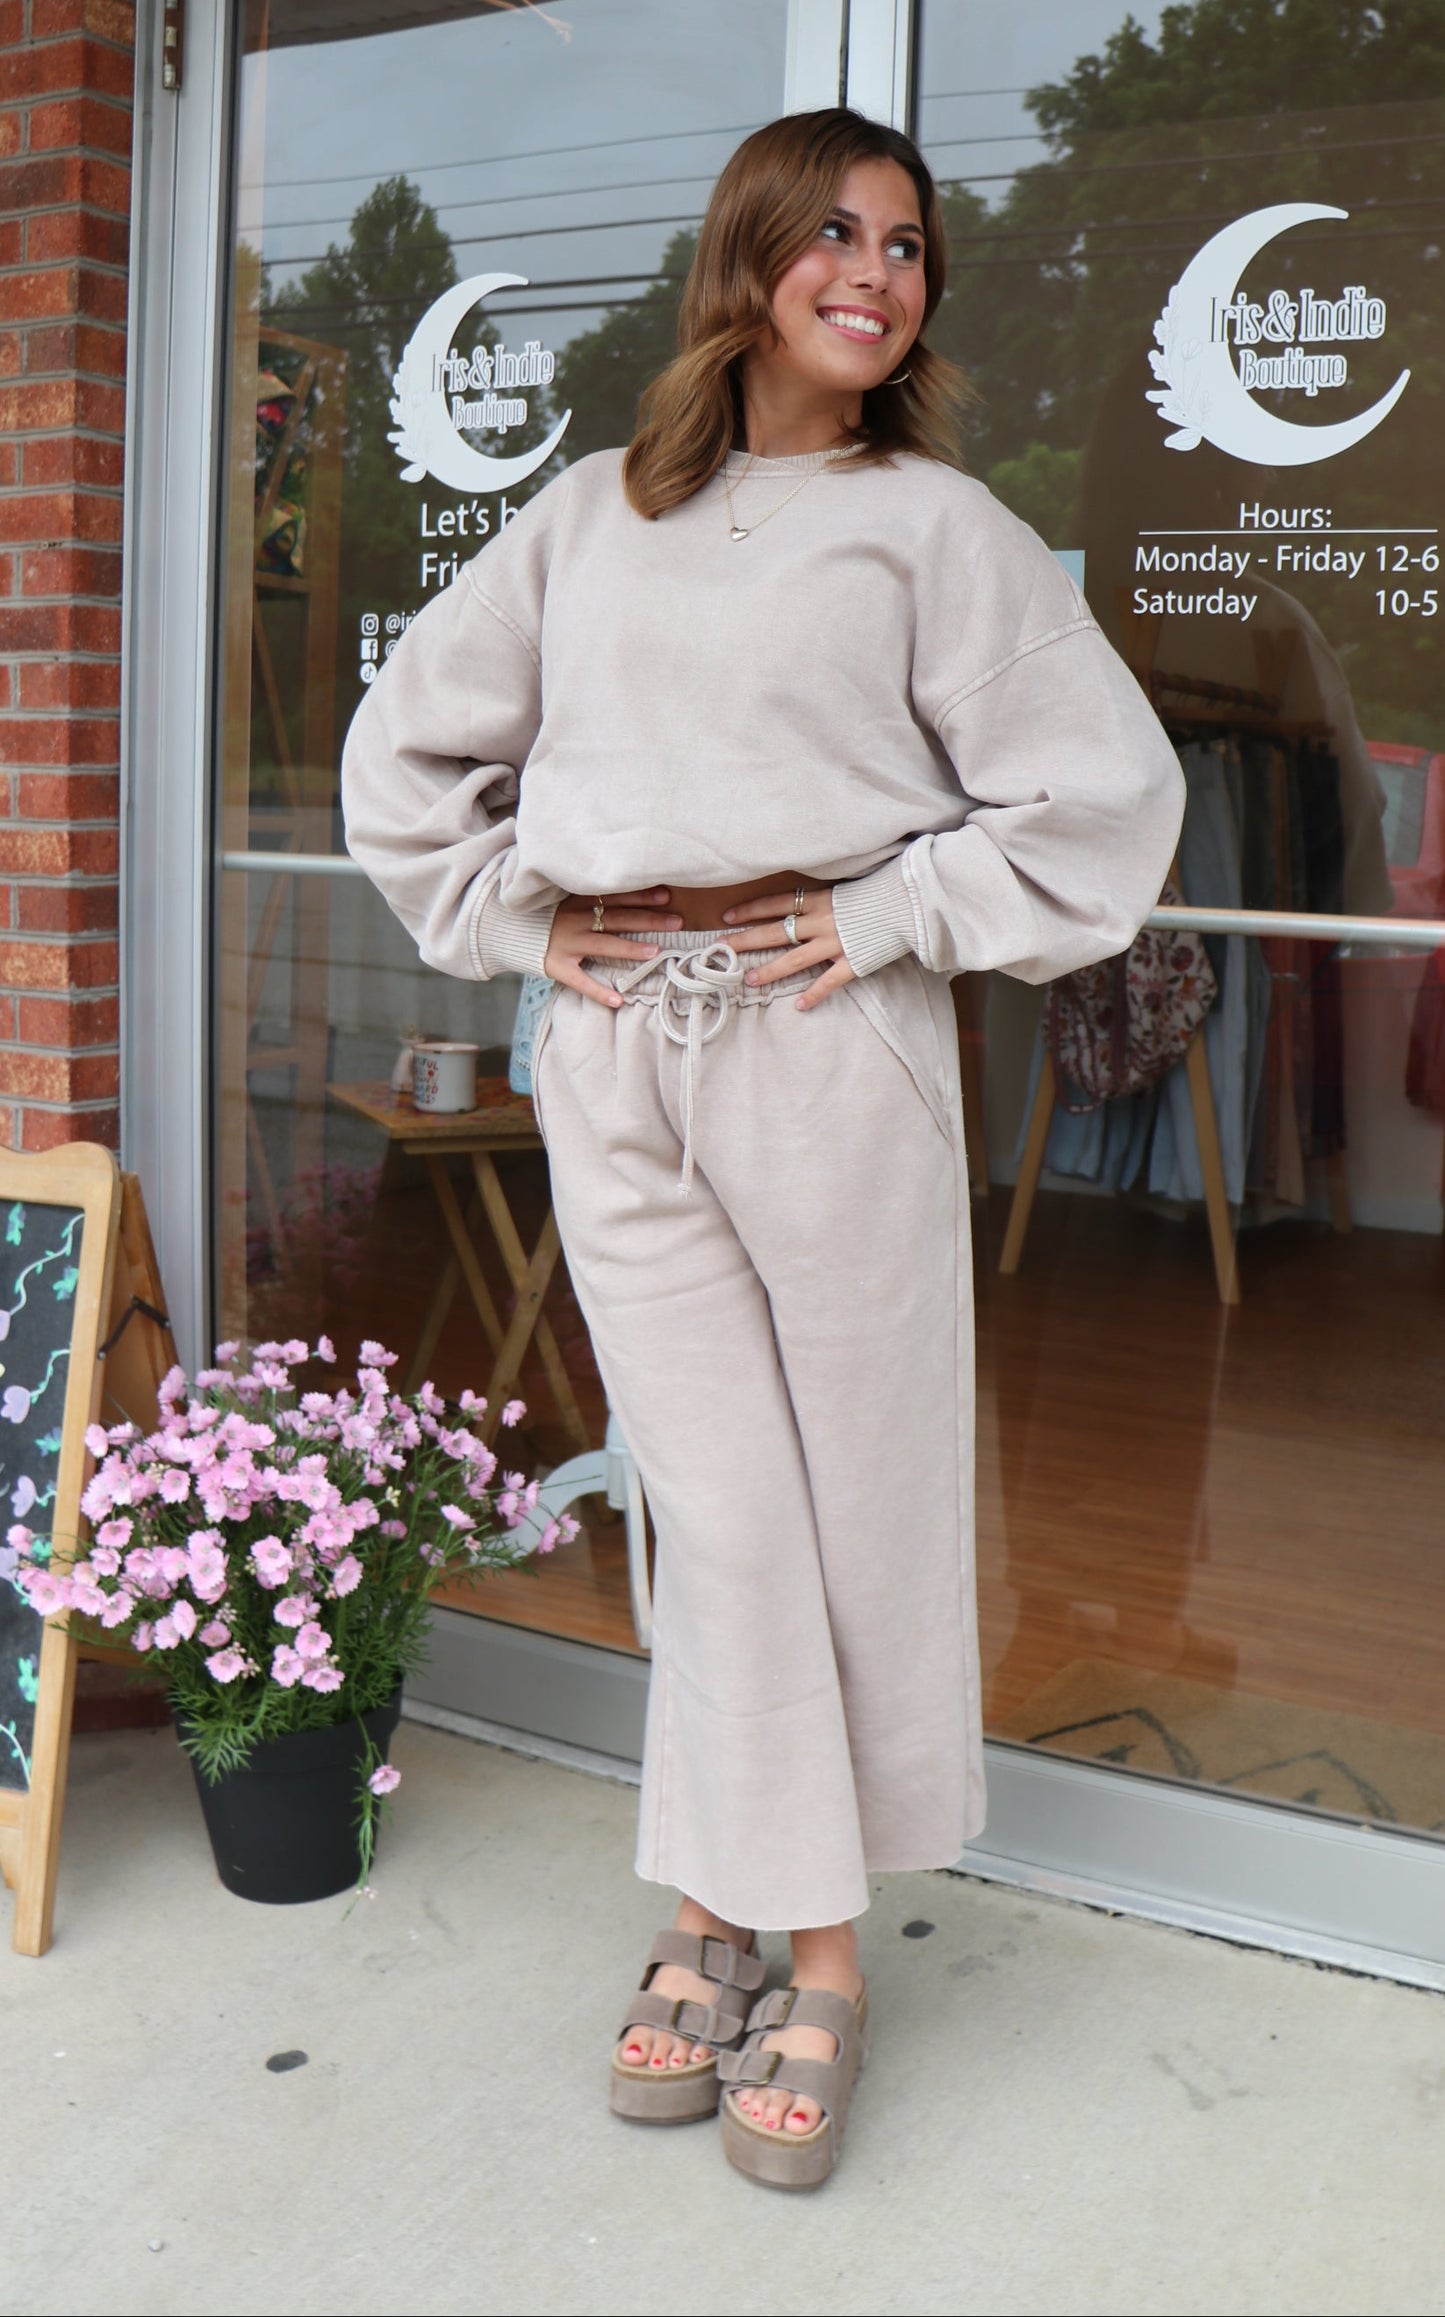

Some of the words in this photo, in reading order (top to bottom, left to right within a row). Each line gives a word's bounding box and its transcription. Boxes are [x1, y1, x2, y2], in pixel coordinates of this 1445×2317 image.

[1240, 347, 1347, 397] Boutique
[452, 393, 527, 434] Boutique
[1239, 502, 1332, 529] Hours:
[1135, 544, 1250, 579] Monday
[1276, 544, 1366, 579] Friday
[1375, 545, 1440, 572] 12-6
[1133, 587, 1257, 622] Saturday
[1375, 590, 1438, 616] 10-5
